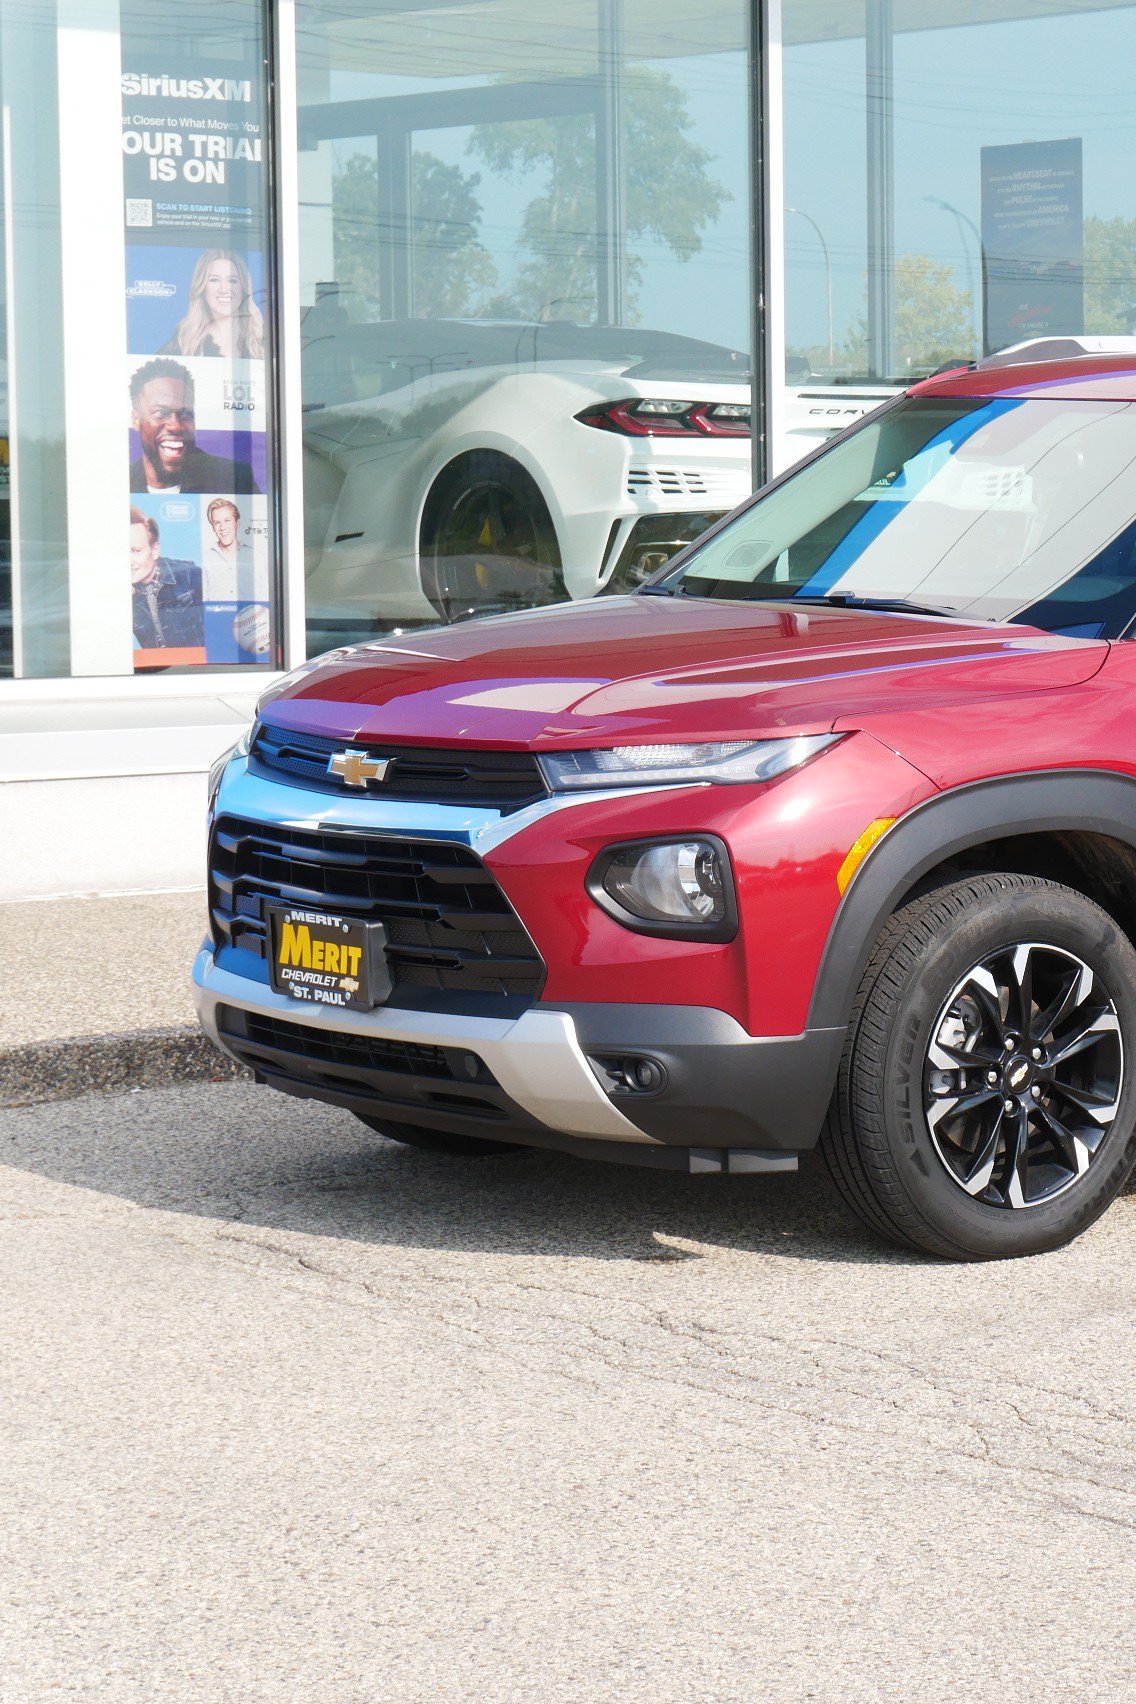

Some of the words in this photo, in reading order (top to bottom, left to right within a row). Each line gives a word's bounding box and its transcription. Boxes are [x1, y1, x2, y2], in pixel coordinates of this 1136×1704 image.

[121, 72, 251, 102] SiriusXM
[122, 116, 131, 125] et
[134, 115, 165, 127] Closer
[168, 116, 177, 127] to
[179, 118, 206, 128] What
[208, 119, 239, 131] Moves
[242, 121, 259, 133] You
[122, 131, 183, 156] OUR
[149, 157, 177, 182] IS
[183, 159, 225, 184] ON
[155, 203, 178, 211] SCAN
[190, 204, 214, 212] START
[223, 385, 256, 401] LOL
[223, 401, 256, 411] RADIO
[290, 910, 343, 927] MERIT
[279, 922, 362, 977] MERIT
[281, 968, 338, 987] CHEVROLET
[293, 984, 312, 1000] ST.
[314, 989, 346, 1006] PAUL
